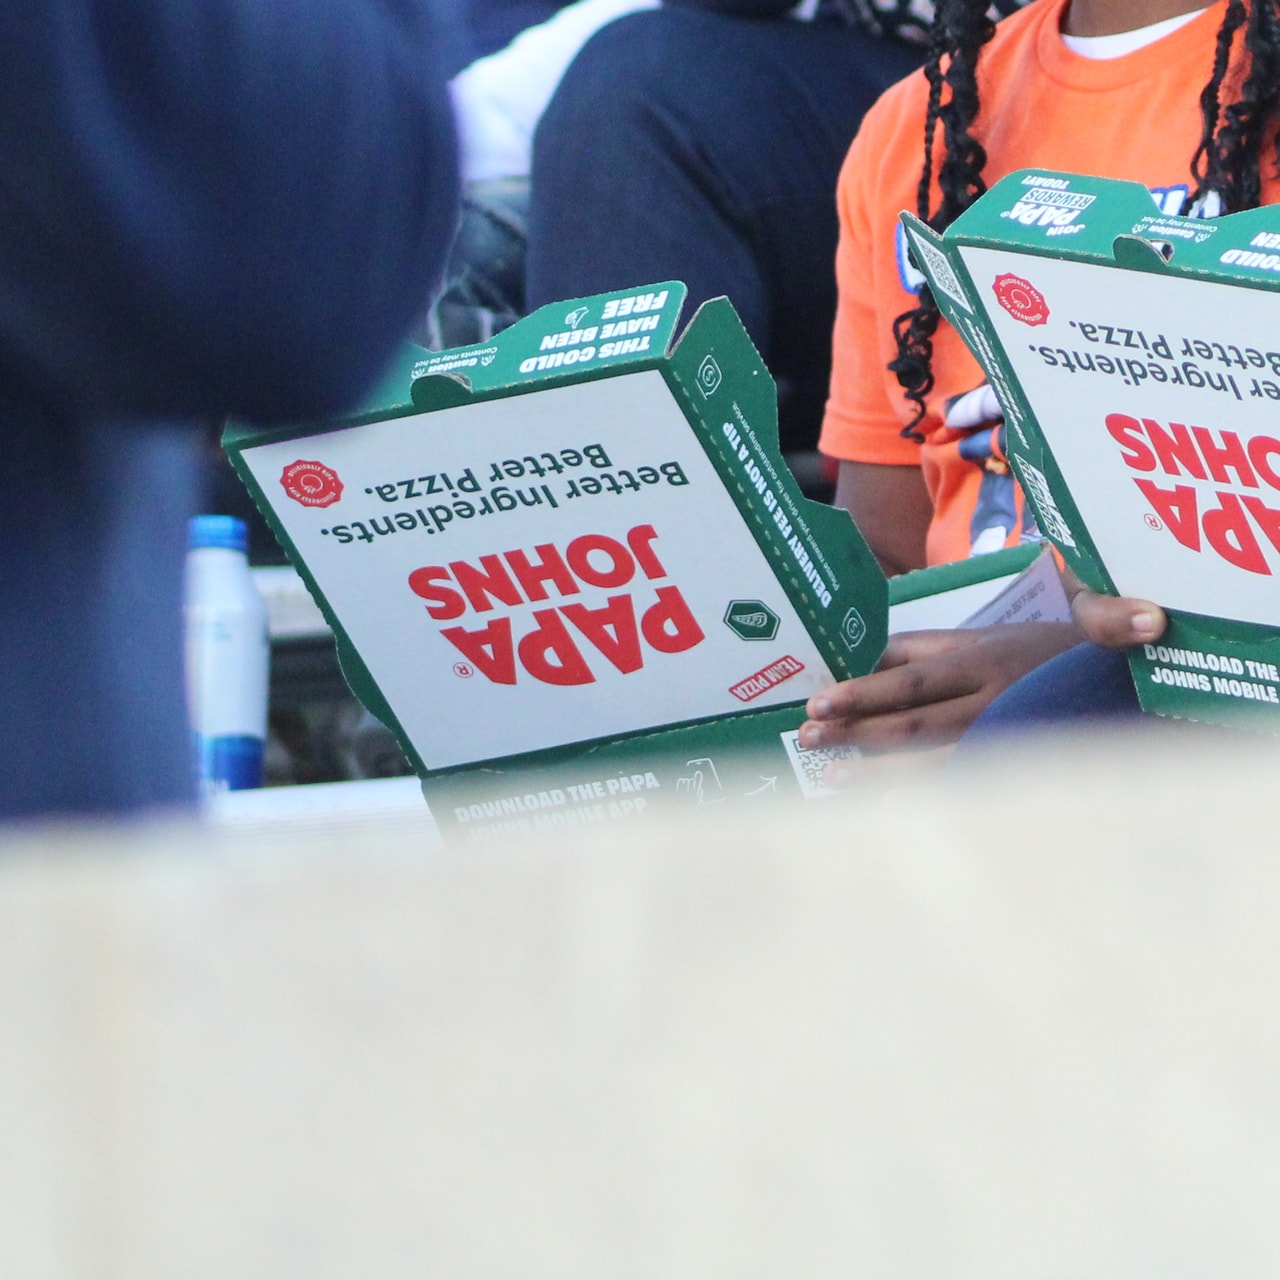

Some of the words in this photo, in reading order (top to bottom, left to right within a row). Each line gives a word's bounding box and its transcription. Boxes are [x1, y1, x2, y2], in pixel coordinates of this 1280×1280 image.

[1021, 175, 1071, 189] TODAY!
[1025, 190, 1092, 207] REWARDS
[1046, 224, 1086, 237] JOIN
[1148, 225, 1195, 239] Caution
[1167, 219, 1183, 227] may
[1182, 221, 1218, 232] Contents
[601, 291, 668, 319] FREE
[540, 326, 599, 351] BEEN
[600, 315, 660, 341] HAVE
[1068, 319, 1174, 360] Pizza.
[441, 354, 460, 362] may
[460, 347, 498, 357] Contents
[519, 346, 595, 373] COULD
[598, 336, 650, 359] THIS
[415, 360, 429, 368] hot
[428, 358, 478, 372] Caution
[1028, 343, 1244, 401] Ingredients.
[722, 422, 743, 451] TIP
[489, 443, 614, 482] Better
[737, 447, 750, 462] A
[748, 430, 777, 480] outstanding
[363, 467, 483, 503] Pizza.
[566, 461, 690, 500] Better
[744, 459, 768, 495] NOT
[775, 480, 786, 494] for
[763, 489, 777, 512] IS
[783, 491, 801, 517] driver
[320, 484, 559, 544] Ingredients.
[773, 506, 793, 539] FEE
[796, 515, 811, 536] your
[806, 535, 826, 564] reward
[408, 523, 667, 620] JOHNS
[787, 534, 833, 608] DELIVERY
[825, 563, 840, 592] Please
[763, 657, 802, 682] TEAM
[1144, 643, 1244, 675] DOWNLOAD
[1245, 660, 1279, 682] THE
[732, 674, 771, 699] PIZZA
[1151, 667, 1212, 692] JOHNS
[1213, 677, 1280, 704] MOBILE
[454, 788, 566, 823] DOWNLOAD
[566, 780, 606, 803] THE
[607, 771, 660, 797] PAPA
[606, 797, 647, 820] APP
